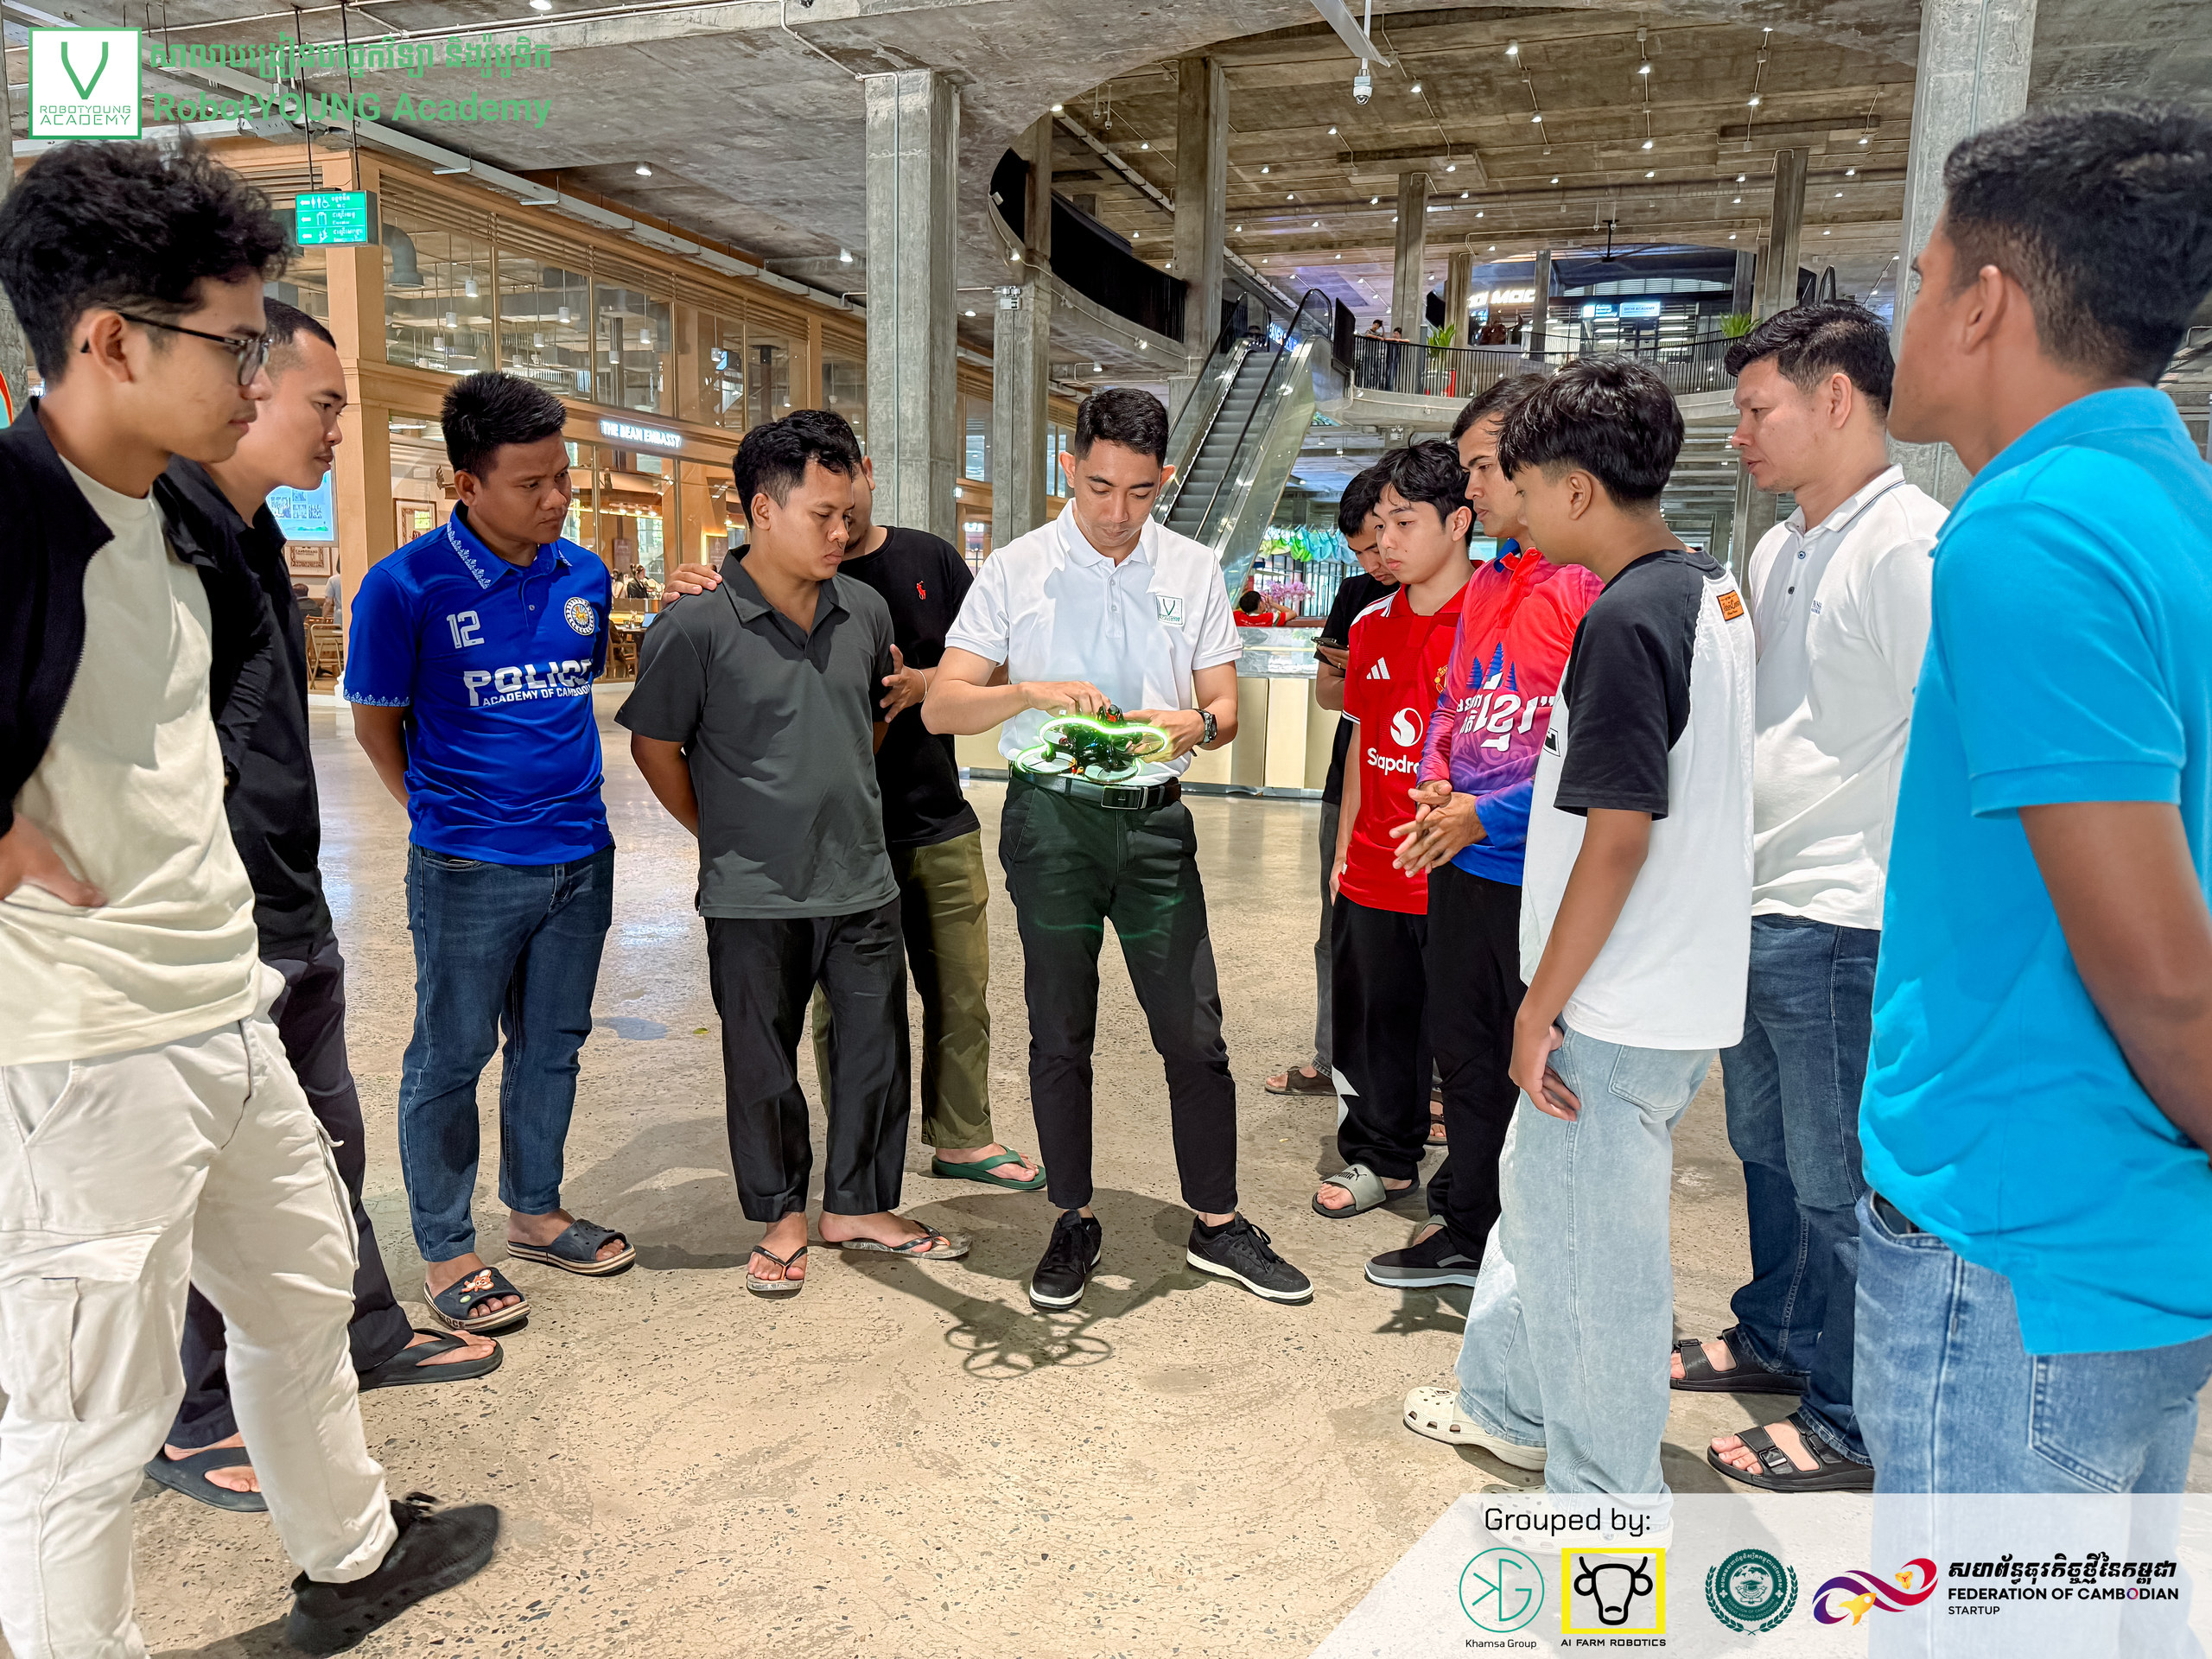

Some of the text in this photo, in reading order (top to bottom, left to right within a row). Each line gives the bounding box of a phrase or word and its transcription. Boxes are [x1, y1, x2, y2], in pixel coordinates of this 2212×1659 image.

[601, 420, 619, 436] THE
[644, 429, 681, 448] EMBASSY
[446, 610, 485, 649] 12
[482, 690, 538, 707] ACADEMY
[541, 688, 554, 699] OF
[1367, 747, 1420, 776] Sapdr
